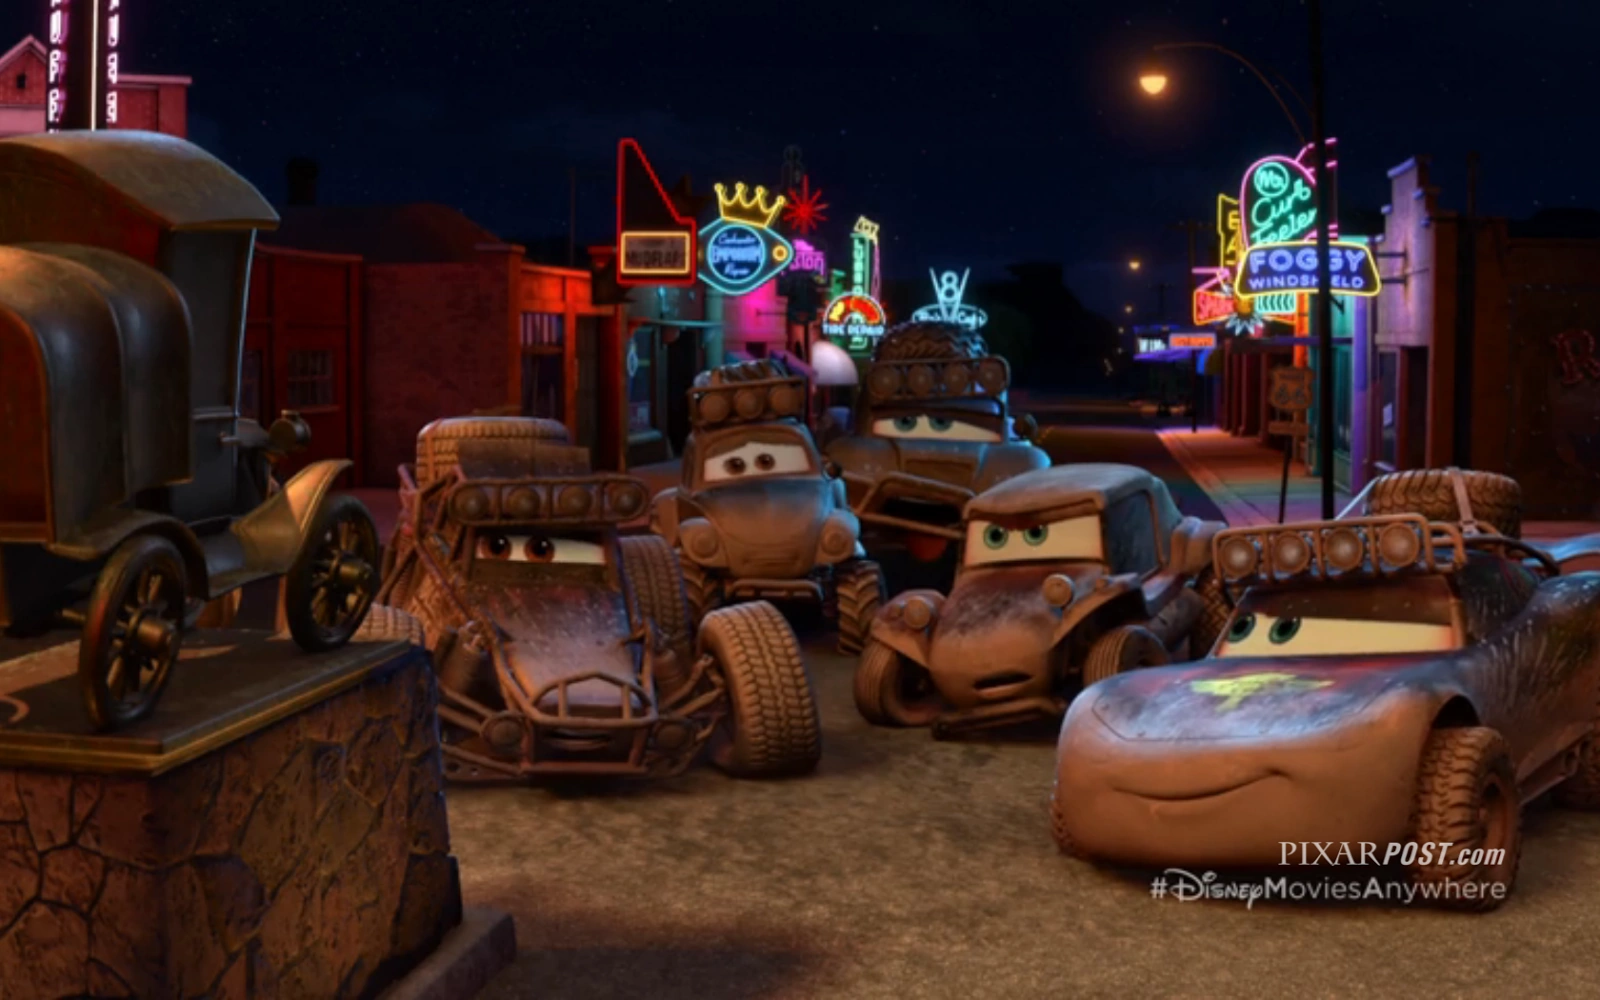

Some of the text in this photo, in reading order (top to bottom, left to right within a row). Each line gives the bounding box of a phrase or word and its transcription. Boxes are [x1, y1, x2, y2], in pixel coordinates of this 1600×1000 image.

[1252, 179, 1312, 227] Curb
[1250, 248, 1366, 273] FOGGY
[1249, 275, 1365, 289] WINDSELD
